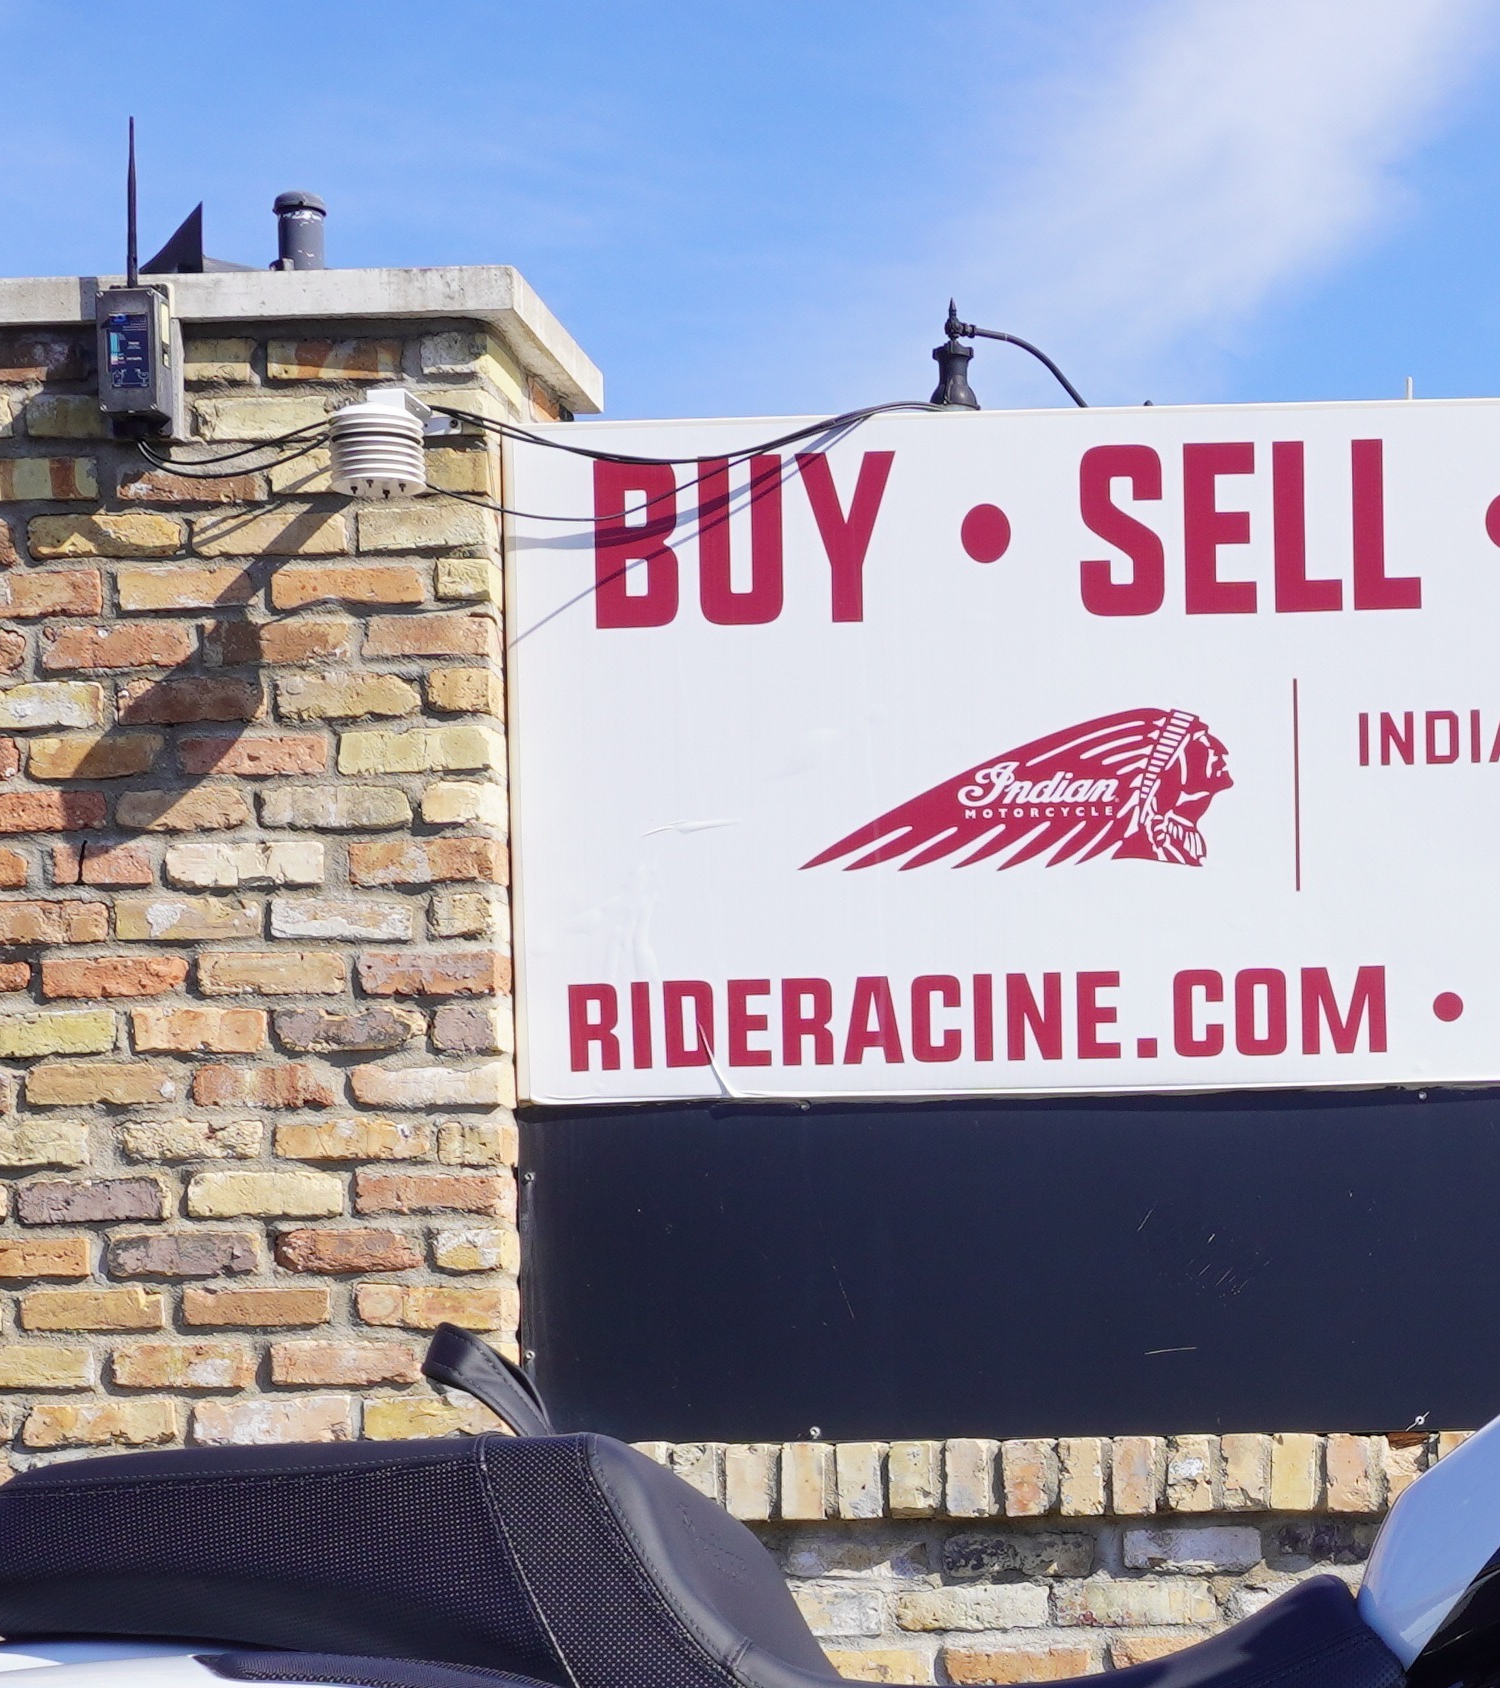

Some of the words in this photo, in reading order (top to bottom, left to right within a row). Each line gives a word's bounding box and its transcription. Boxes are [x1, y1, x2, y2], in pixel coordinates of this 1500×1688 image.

[594, 450, 894, 630] BUY
[1080, 438, 1422, 617] SELL
[957, 761, 1120, 807] Indian
[964, 805, 1114, 819] MOTORCYCLE
[567, 965, 1388, 1073] RIDERACINE.COM
